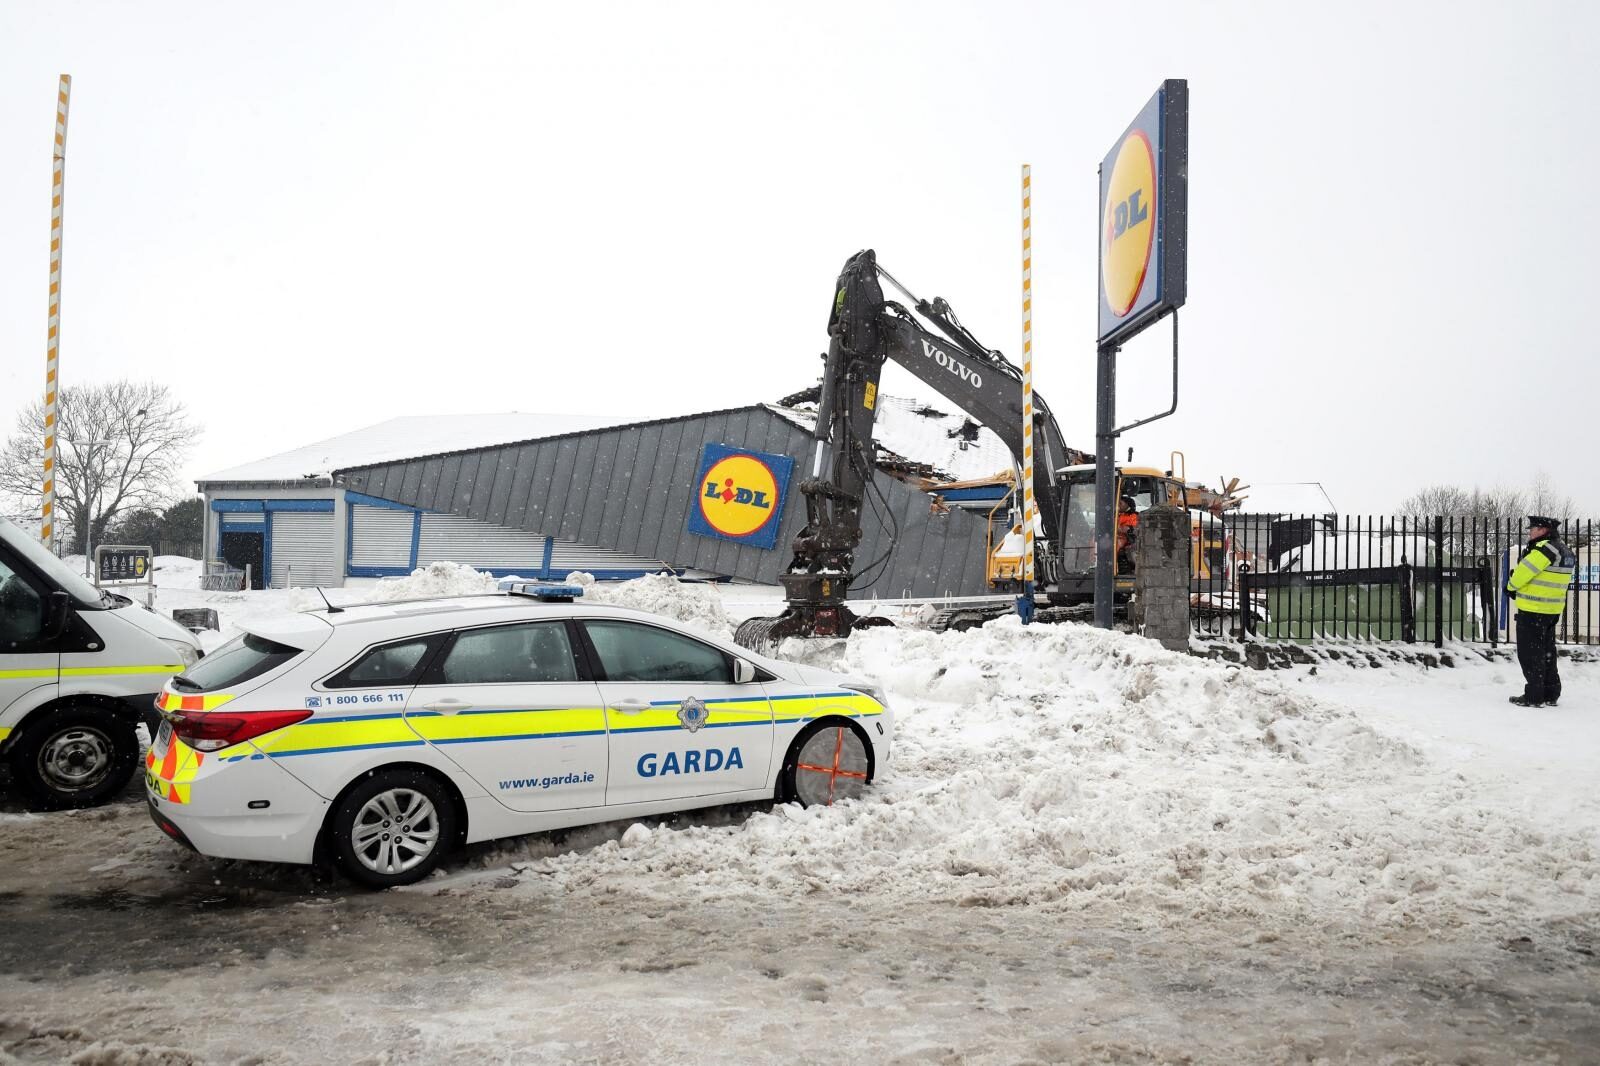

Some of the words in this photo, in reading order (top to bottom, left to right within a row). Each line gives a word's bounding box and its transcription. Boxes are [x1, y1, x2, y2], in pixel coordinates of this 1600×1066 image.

[920, 338, 983, 389] VOLVO
[325, 697, 332, 705] 1
[336, 695, 358, 705] 800
[362, 694, 383, 703] 666
[387, 693, 404, 702] 111
[636, 746, 744, 778] GARDA
[498, 771, 595, 789] www.garda.ie
